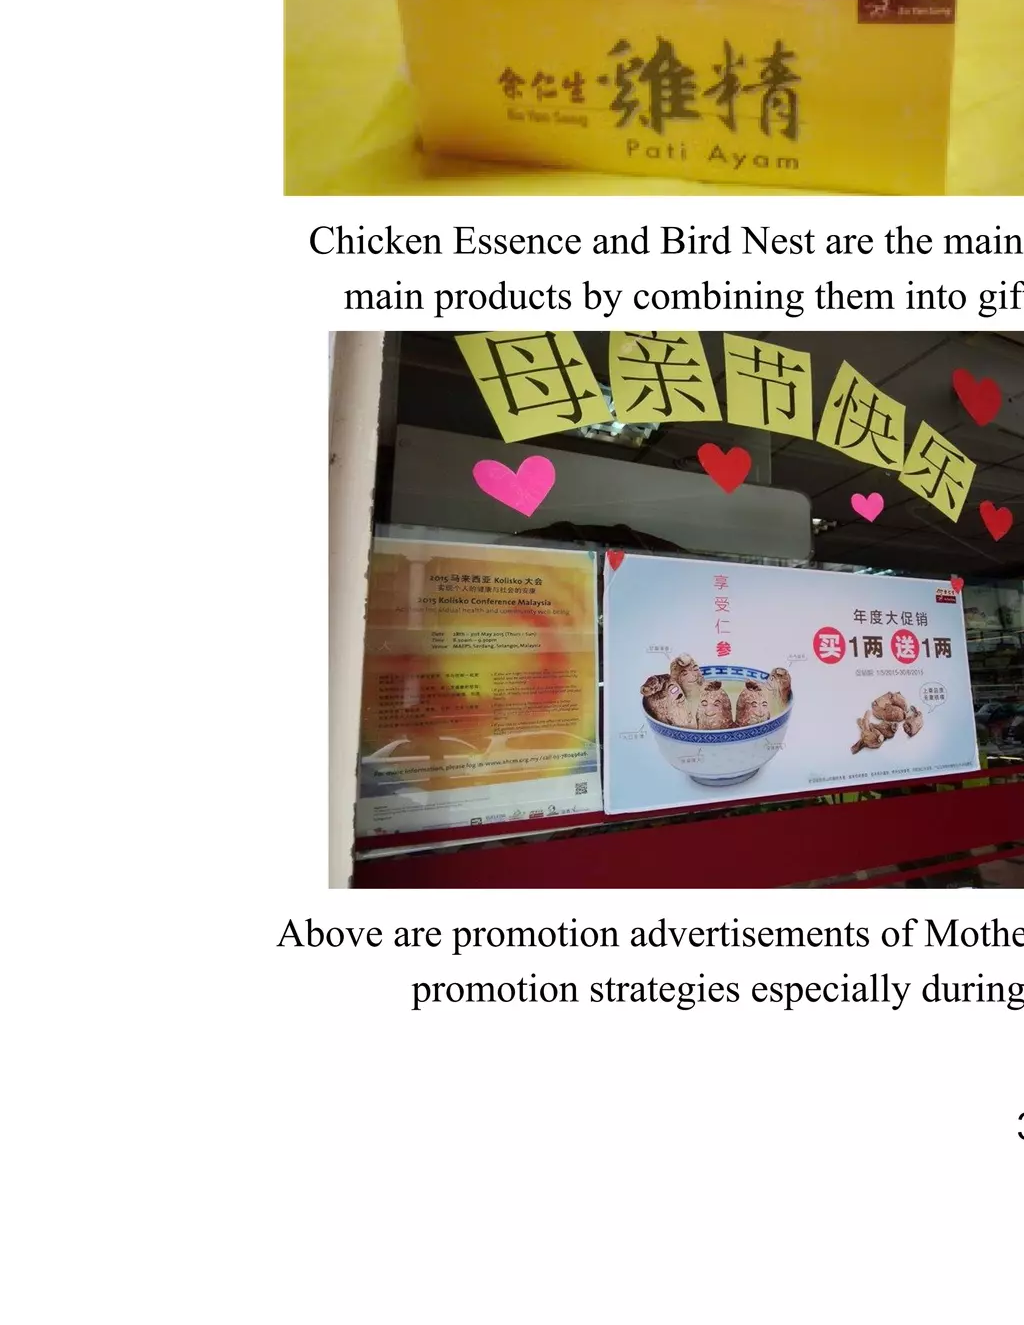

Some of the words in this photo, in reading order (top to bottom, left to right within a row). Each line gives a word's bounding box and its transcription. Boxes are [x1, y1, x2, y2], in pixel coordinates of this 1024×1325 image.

[498, 66, 587, 103] 余仁生
[625, 139, 687, 160] Pati
[707, 144, 801, 171] Ayam
[310, 226, 442, 254] Chicken
[454, 227, 581, 254] Essence
[593, 226, 650, 254] and
[661, 226, 731, 254] Bird
[741, 227, 815, 254] Nest
[826, 235, 873, 254] are
[885, 226, 932, 254] the
[944, 226, 1023, 254] main
[344, 281, 424, 309] main
[434, 281, 571, 317] products
[583, 281, 622, 317] by
[634, 281, 804, 317] combining
[815, 281, 894, 309] them
[906, 281, 966, 309] into
[494, 577, 523, 585] Kolisko
[524, 577, 543, 586] 大会
[438, 597, 469, 605] Kolisko
[471, 597, 517, 606] Conference
[517, 598, 552, 607] Malaysia
[853, 608, 929, 627] 年度大促销
[277, 918, 382, 947] Above
[395, 928, 441, 947] are
[452, 918, 619, 955] promotion
[631, 918, 869, 947] advertisements
[882, 918, 918, 947] of
[412, 973, 578, 1010] promotion
[591, 973, 739, 1010] strategies
[752, 974, 911, 1010] especially
[923, 973, 1024, 1010] during
